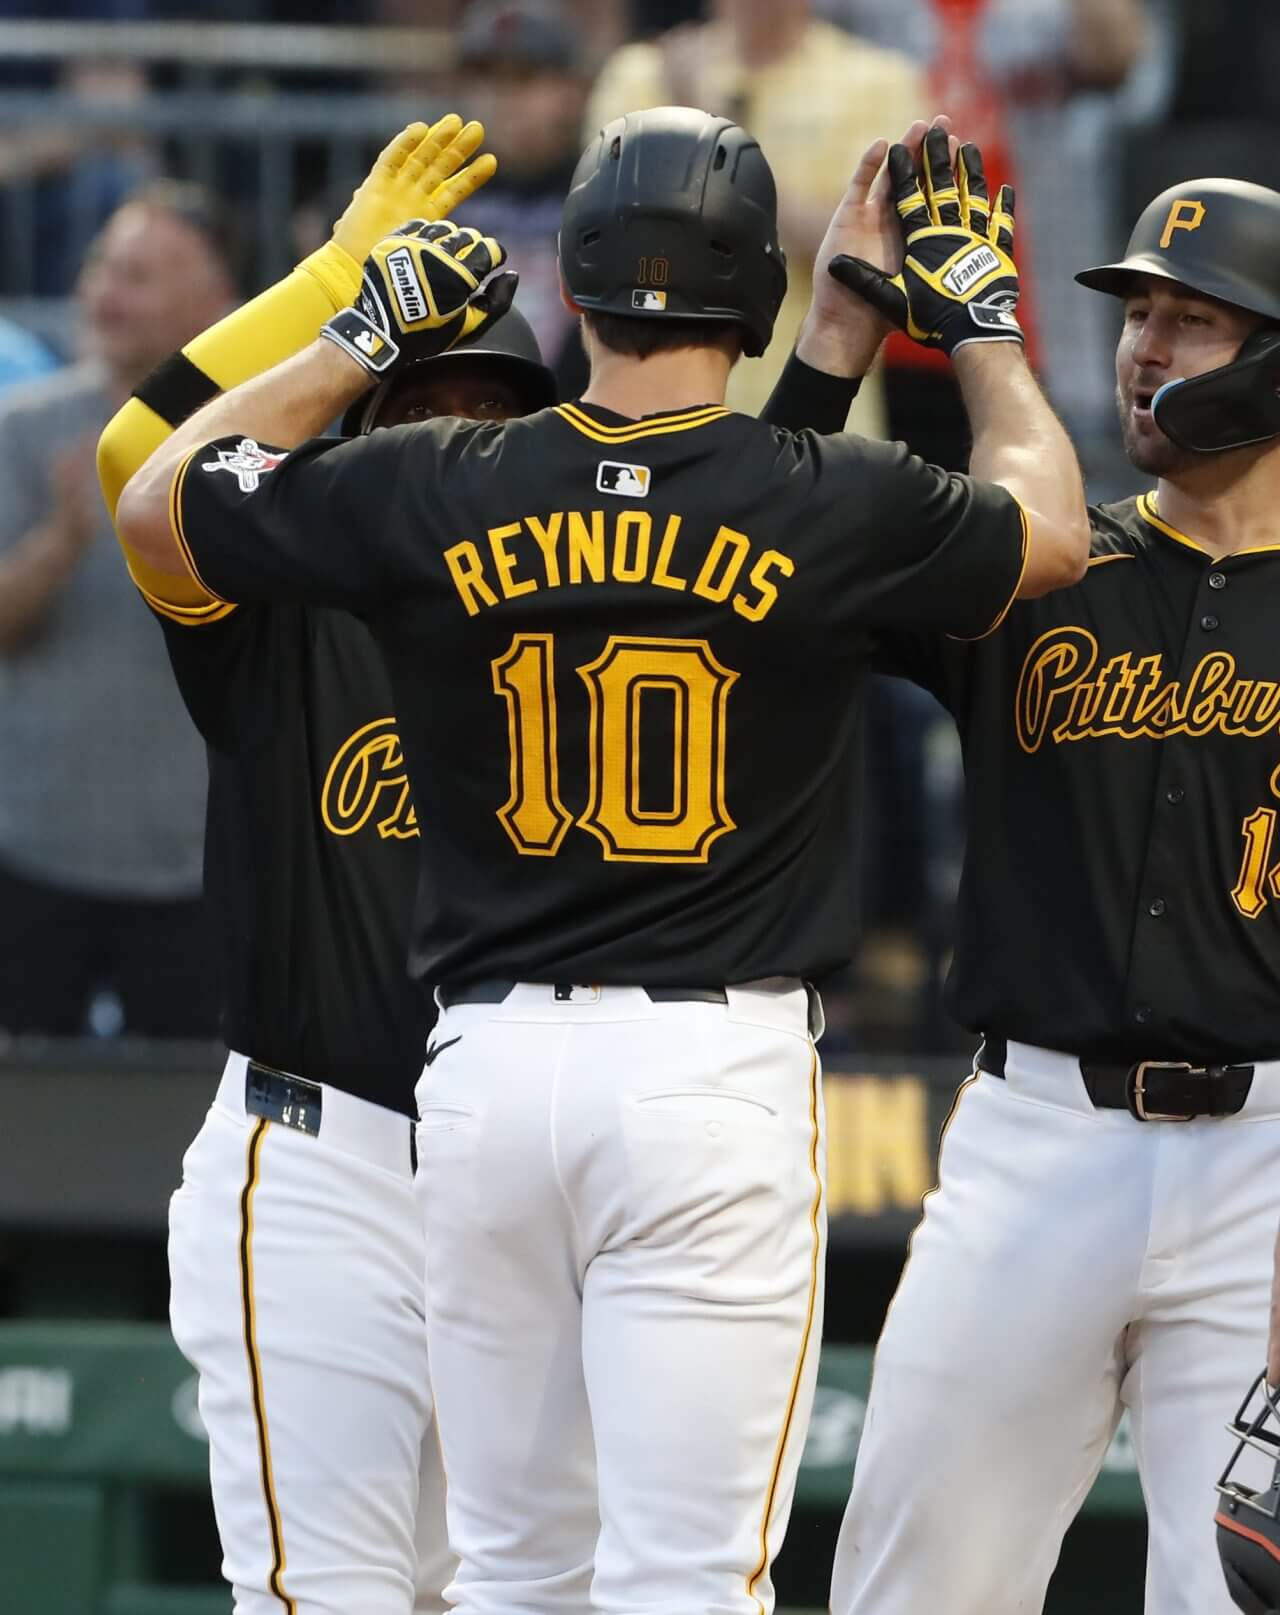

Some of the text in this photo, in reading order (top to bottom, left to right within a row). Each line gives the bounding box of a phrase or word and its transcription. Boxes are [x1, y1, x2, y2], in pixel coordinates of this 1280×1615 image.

[1159, 199, 1206, 248] P
[638, 256, 669, 286] 10
[443, 510, 795, 622] REYNOLDS
[490, 632, 742, 863] 10
